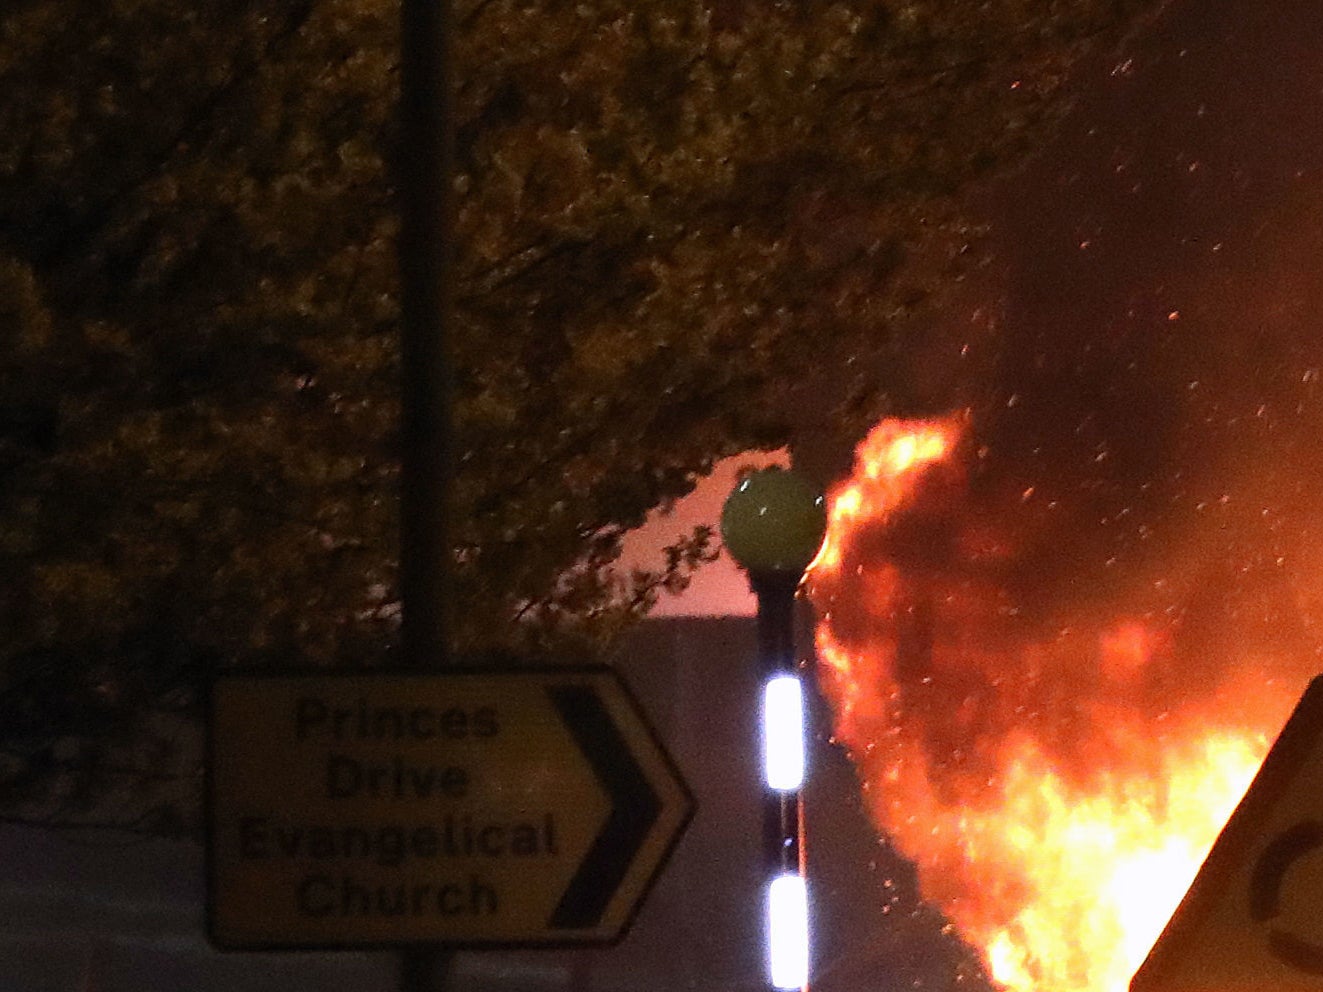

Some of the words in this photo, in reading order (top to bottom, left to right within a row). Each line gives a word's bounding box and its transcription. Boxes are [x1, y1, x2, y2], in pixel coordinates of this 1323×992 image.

[297, 698, 499, 740] Princes
[328, 755, 469, 798] Drive
[239, 812, 559, 867] Evangelical
[300, 874, 498, 918] Church
